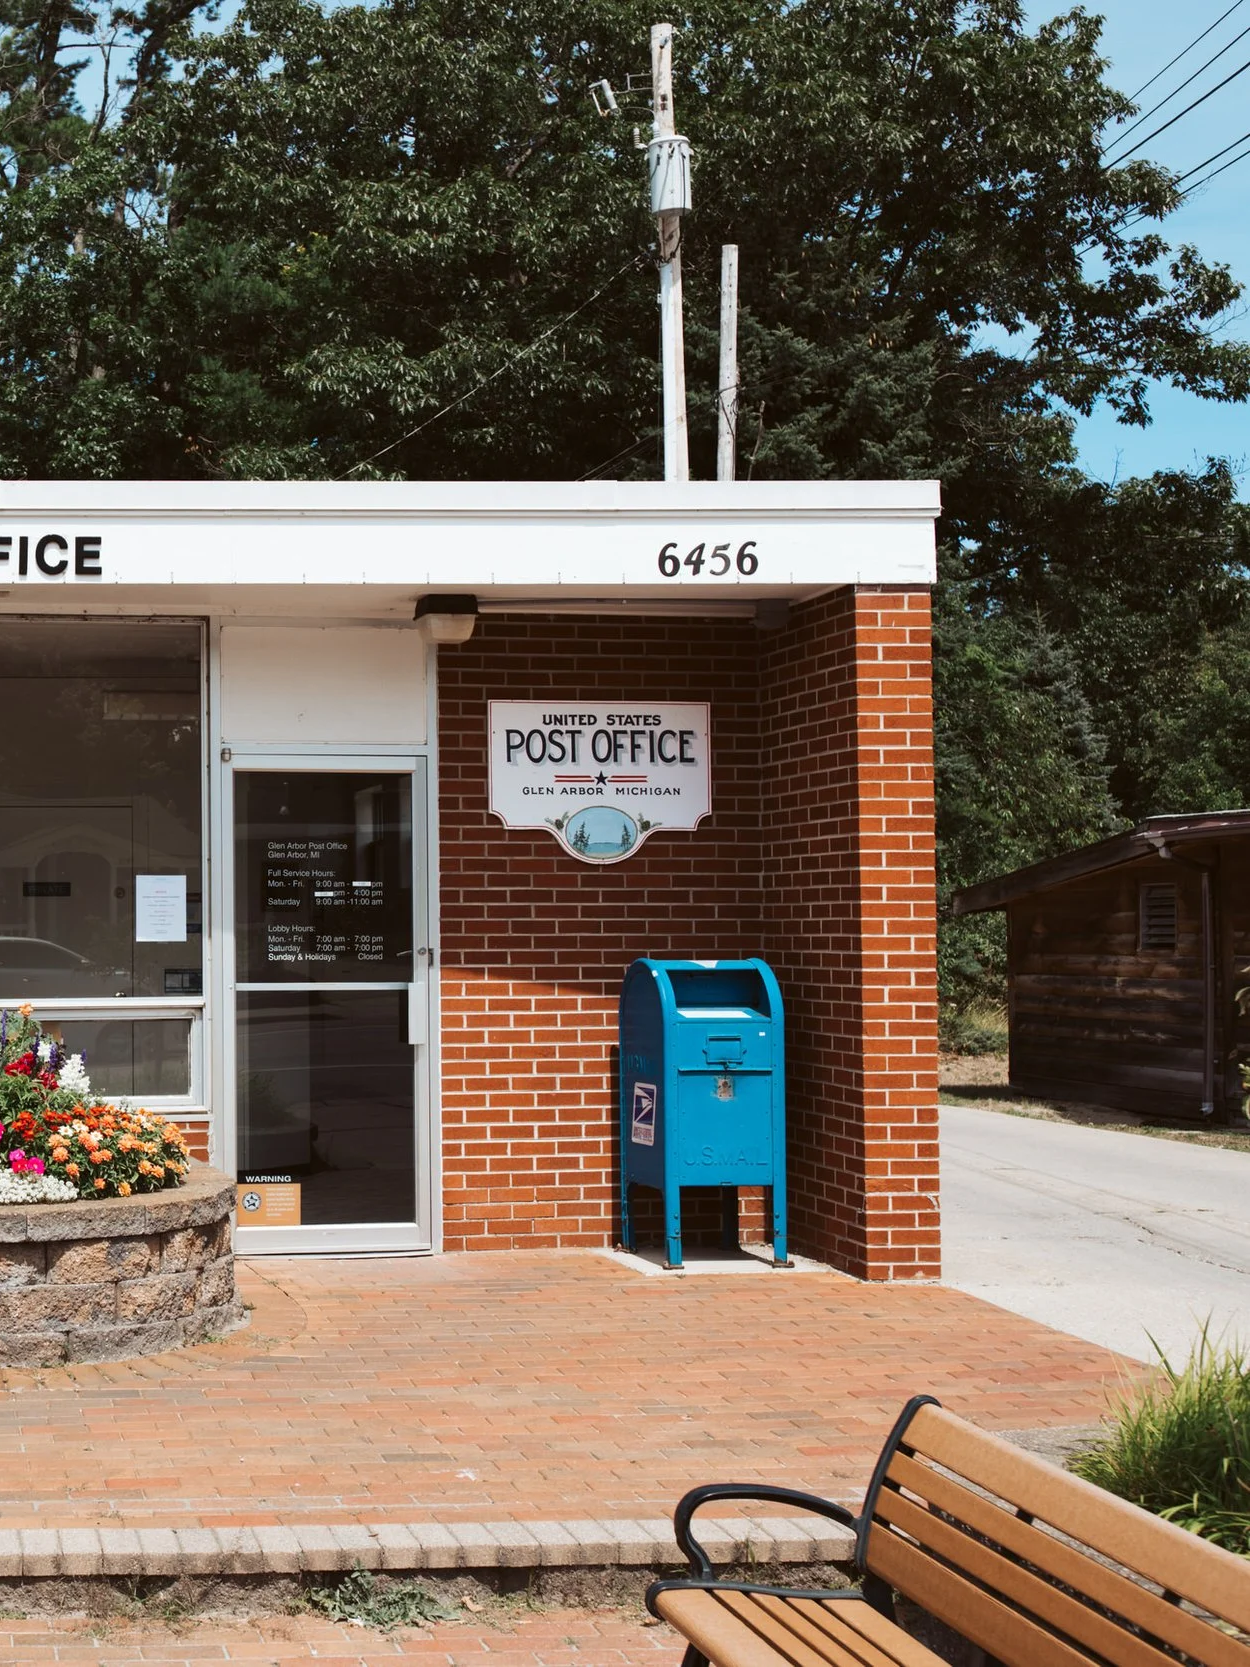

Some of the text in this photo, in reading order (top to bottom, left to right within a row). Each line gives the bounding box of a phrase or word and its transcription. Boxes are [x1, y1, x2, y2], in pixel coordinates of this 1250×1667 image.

[658, 541, 759, 577] 6456
[542, 714, 662, 726] UNITED STATES
[505, 729, 696, 764] POST OFFICE
[522, 787, 681, 796] GLEN ARBOR MICHIGAN
[268, 842, 348, 850] Glen Arbor Post Office
[268, 851, 285, 859] Glen
[286, 851, 308, 859] Arbor,
[268, 869, 336, 877] Full Service Hours:
[268, 898, 301, 906] Saturday
[268, 924, 290, 933] Lobby
[268, 944, 301, 953] Saturday
[268, 954, 296, 962] Sunday
[305, 954, 336, 962] Holidays
[246, 1175, 292, 1183] WARNING
